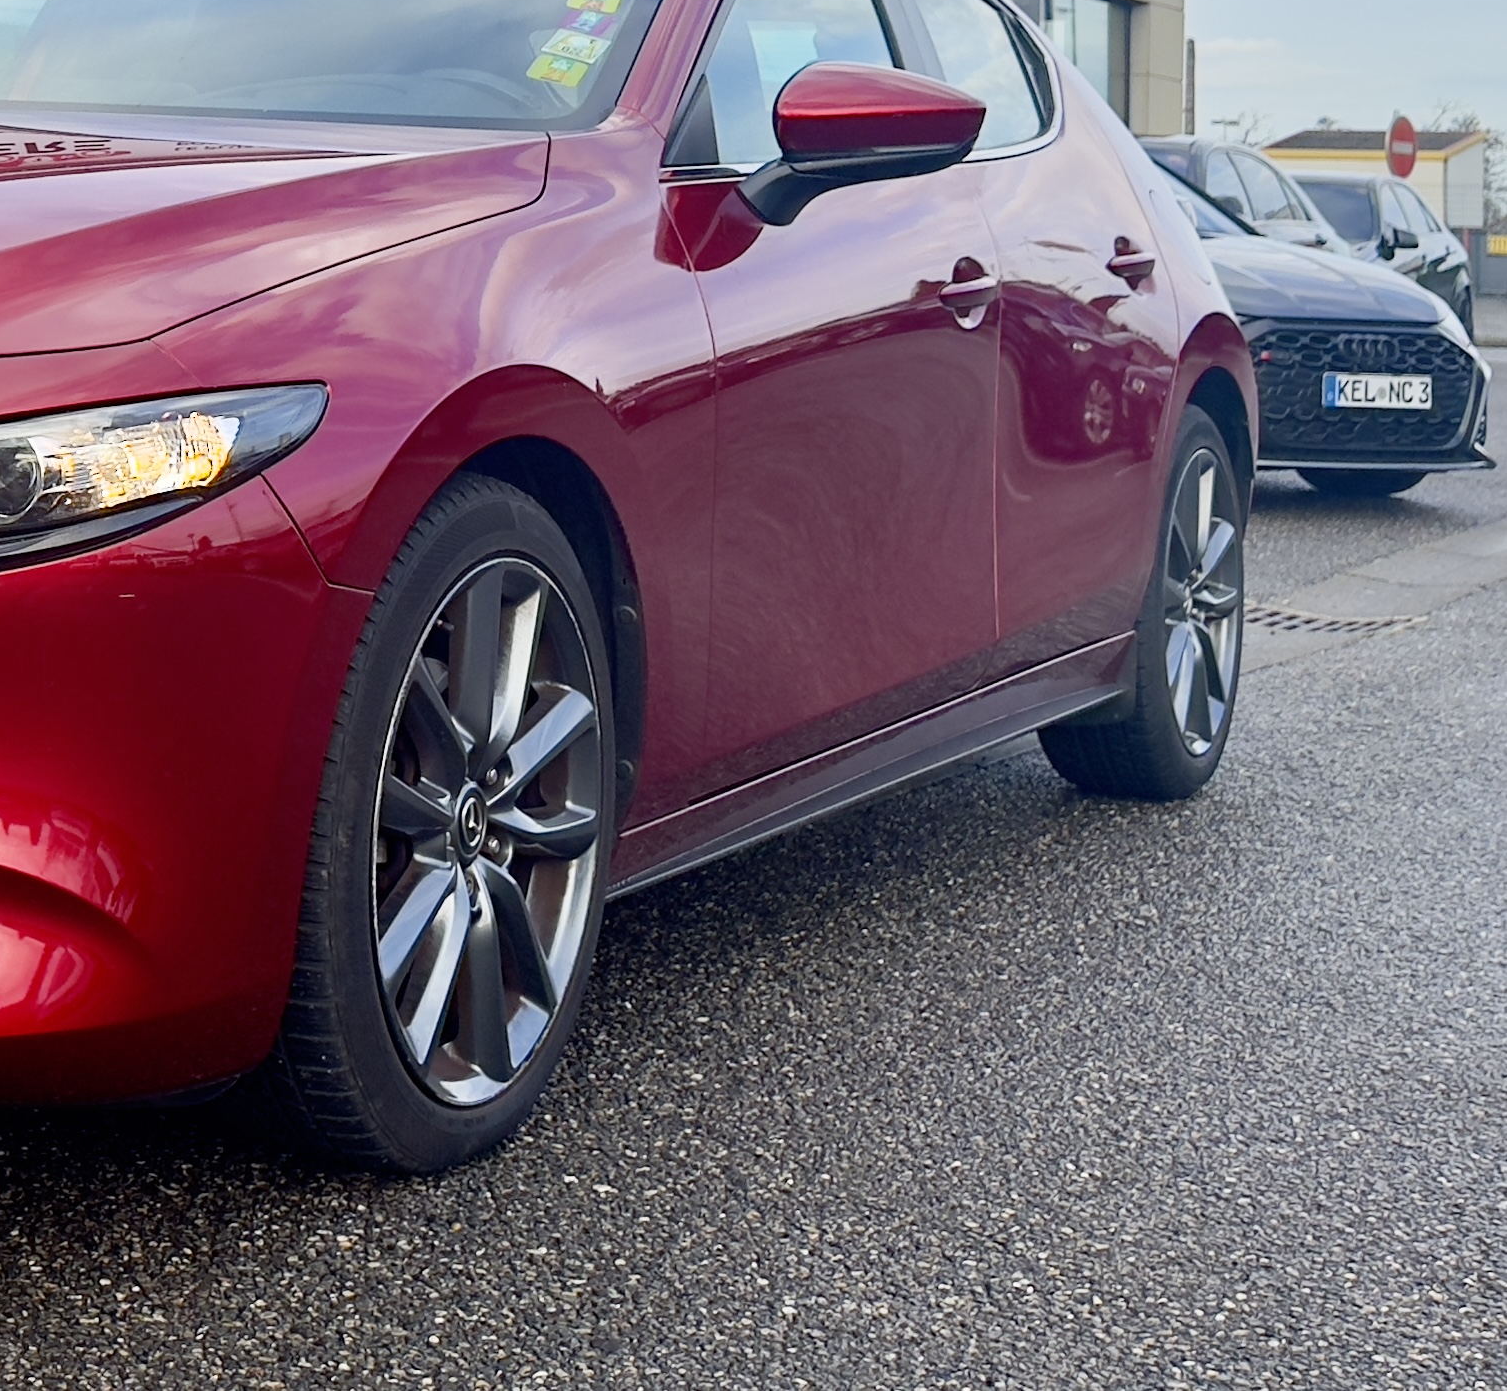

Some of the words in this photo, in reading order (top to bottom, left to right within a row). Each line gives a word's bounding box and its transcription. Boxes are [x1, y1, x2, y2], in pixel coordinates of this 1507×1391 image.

[1338, 379, 1376, 403] KEL
[1389, 380, 1413, 404] NC
[1419, 381, 1429, 404] 3
